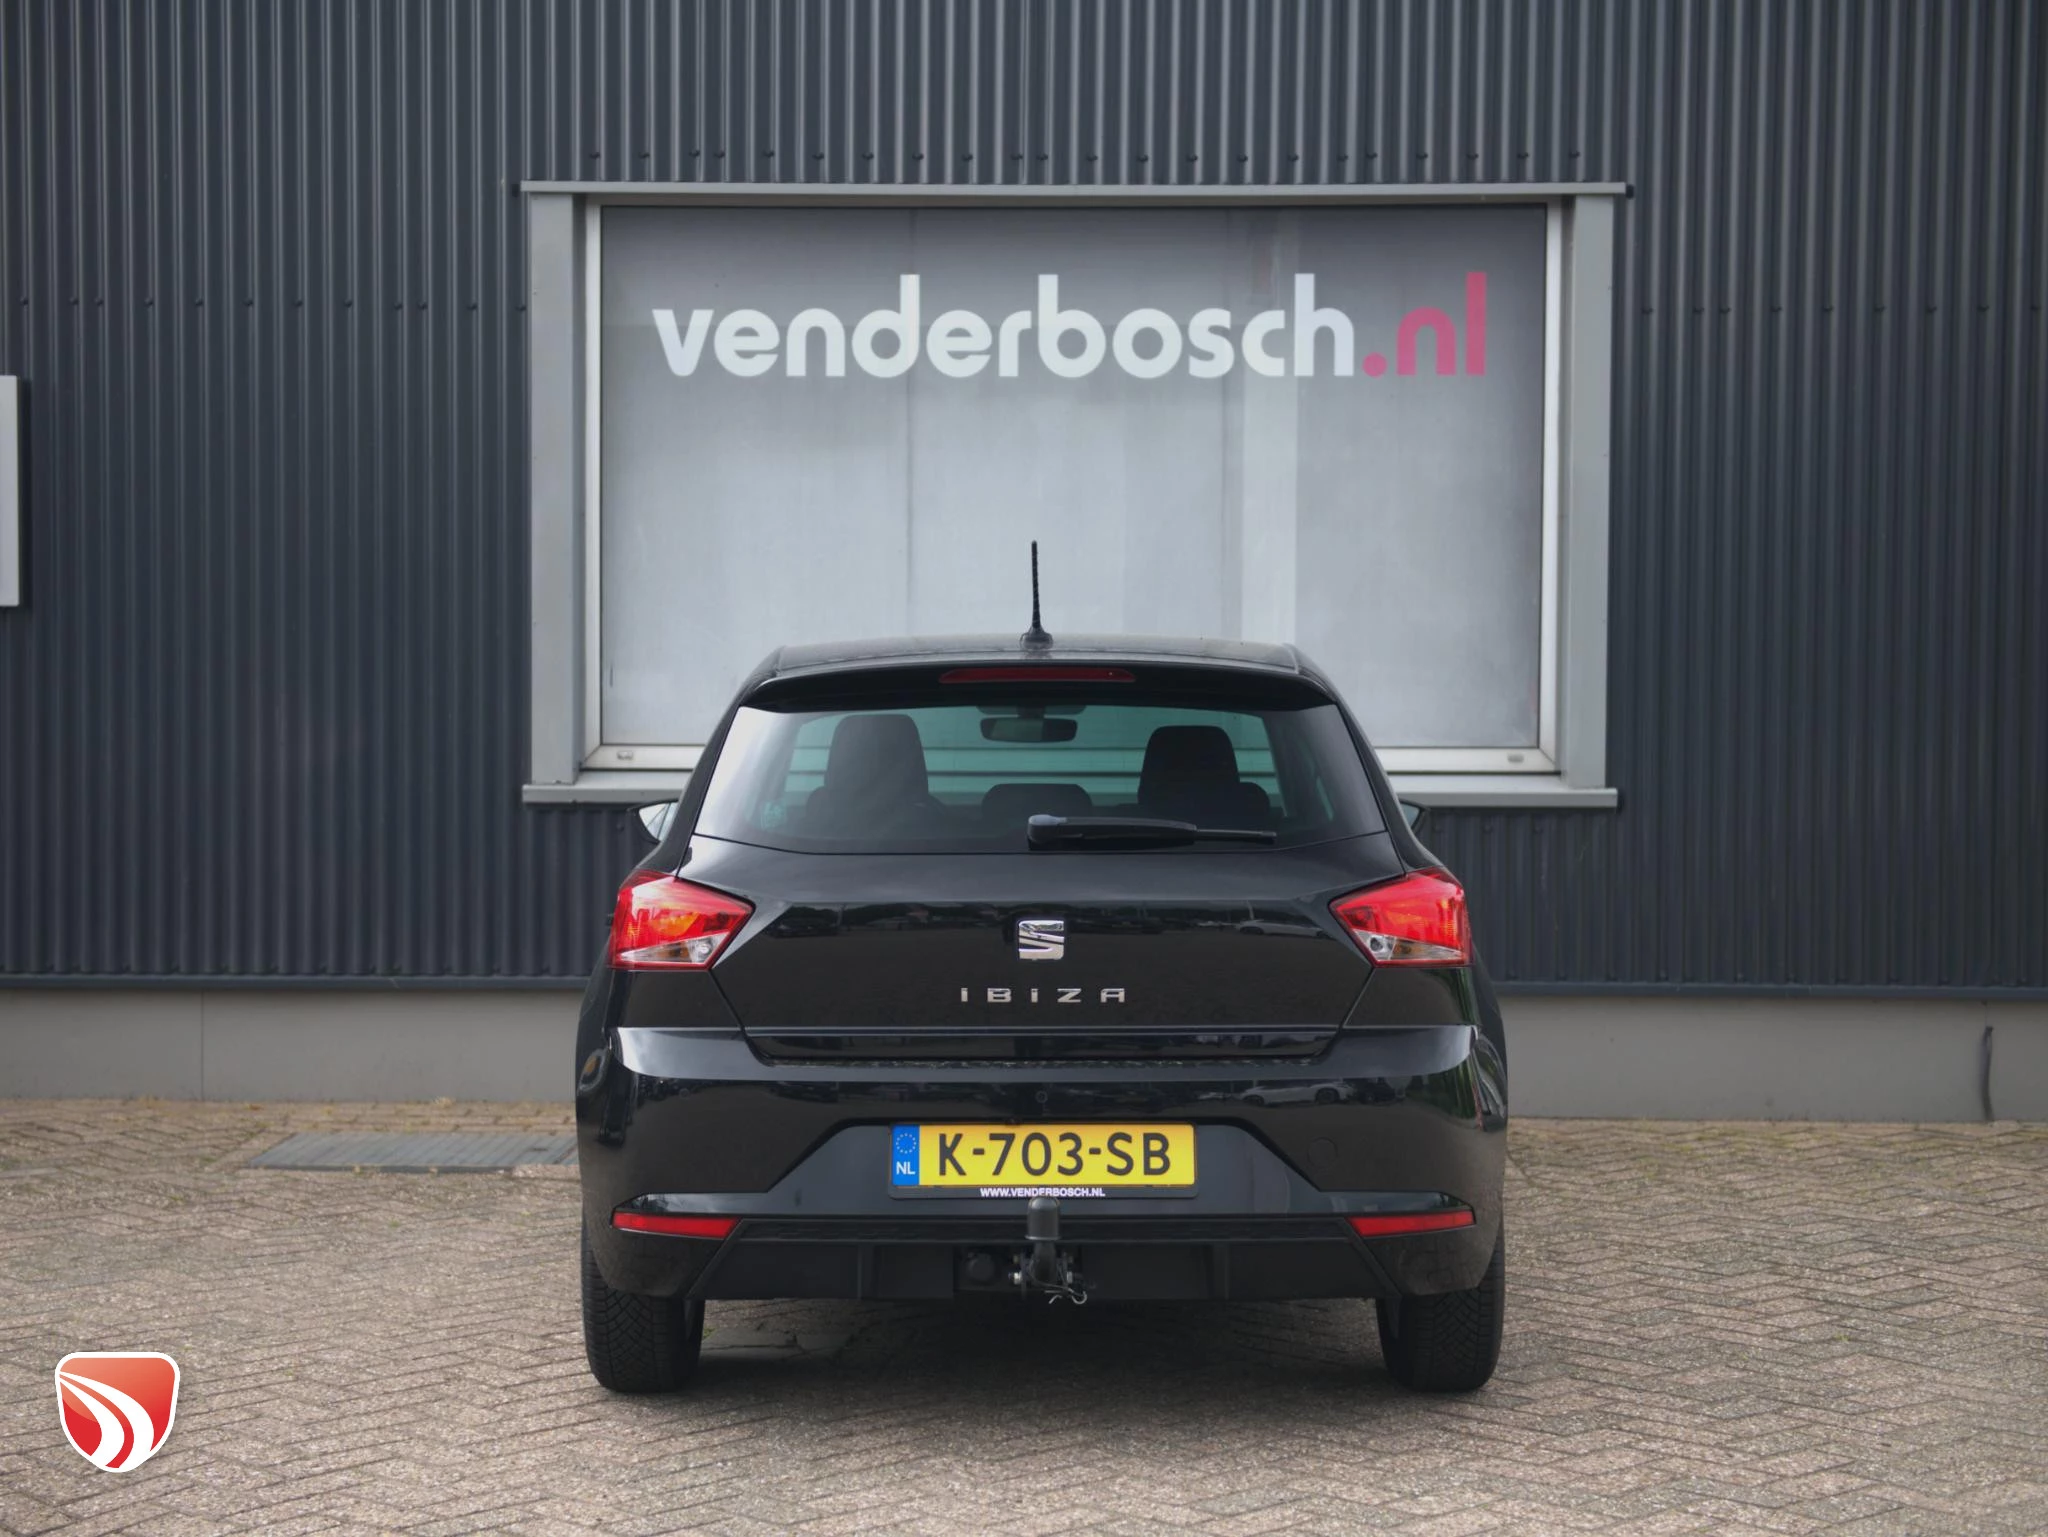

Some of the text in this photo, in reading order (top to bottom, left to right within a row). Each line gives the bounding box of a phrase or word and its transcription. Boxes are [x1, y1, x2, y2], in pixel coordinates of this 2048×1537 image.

[651, 271, 1488, 379] venderbosch.nl
[896, 1161, 916, 1176] NL
[938, 1131, 1171, 1177] K-703-SB
[979, 1187, 1106, 1198] WWW.VENDERBOSCH.NL
